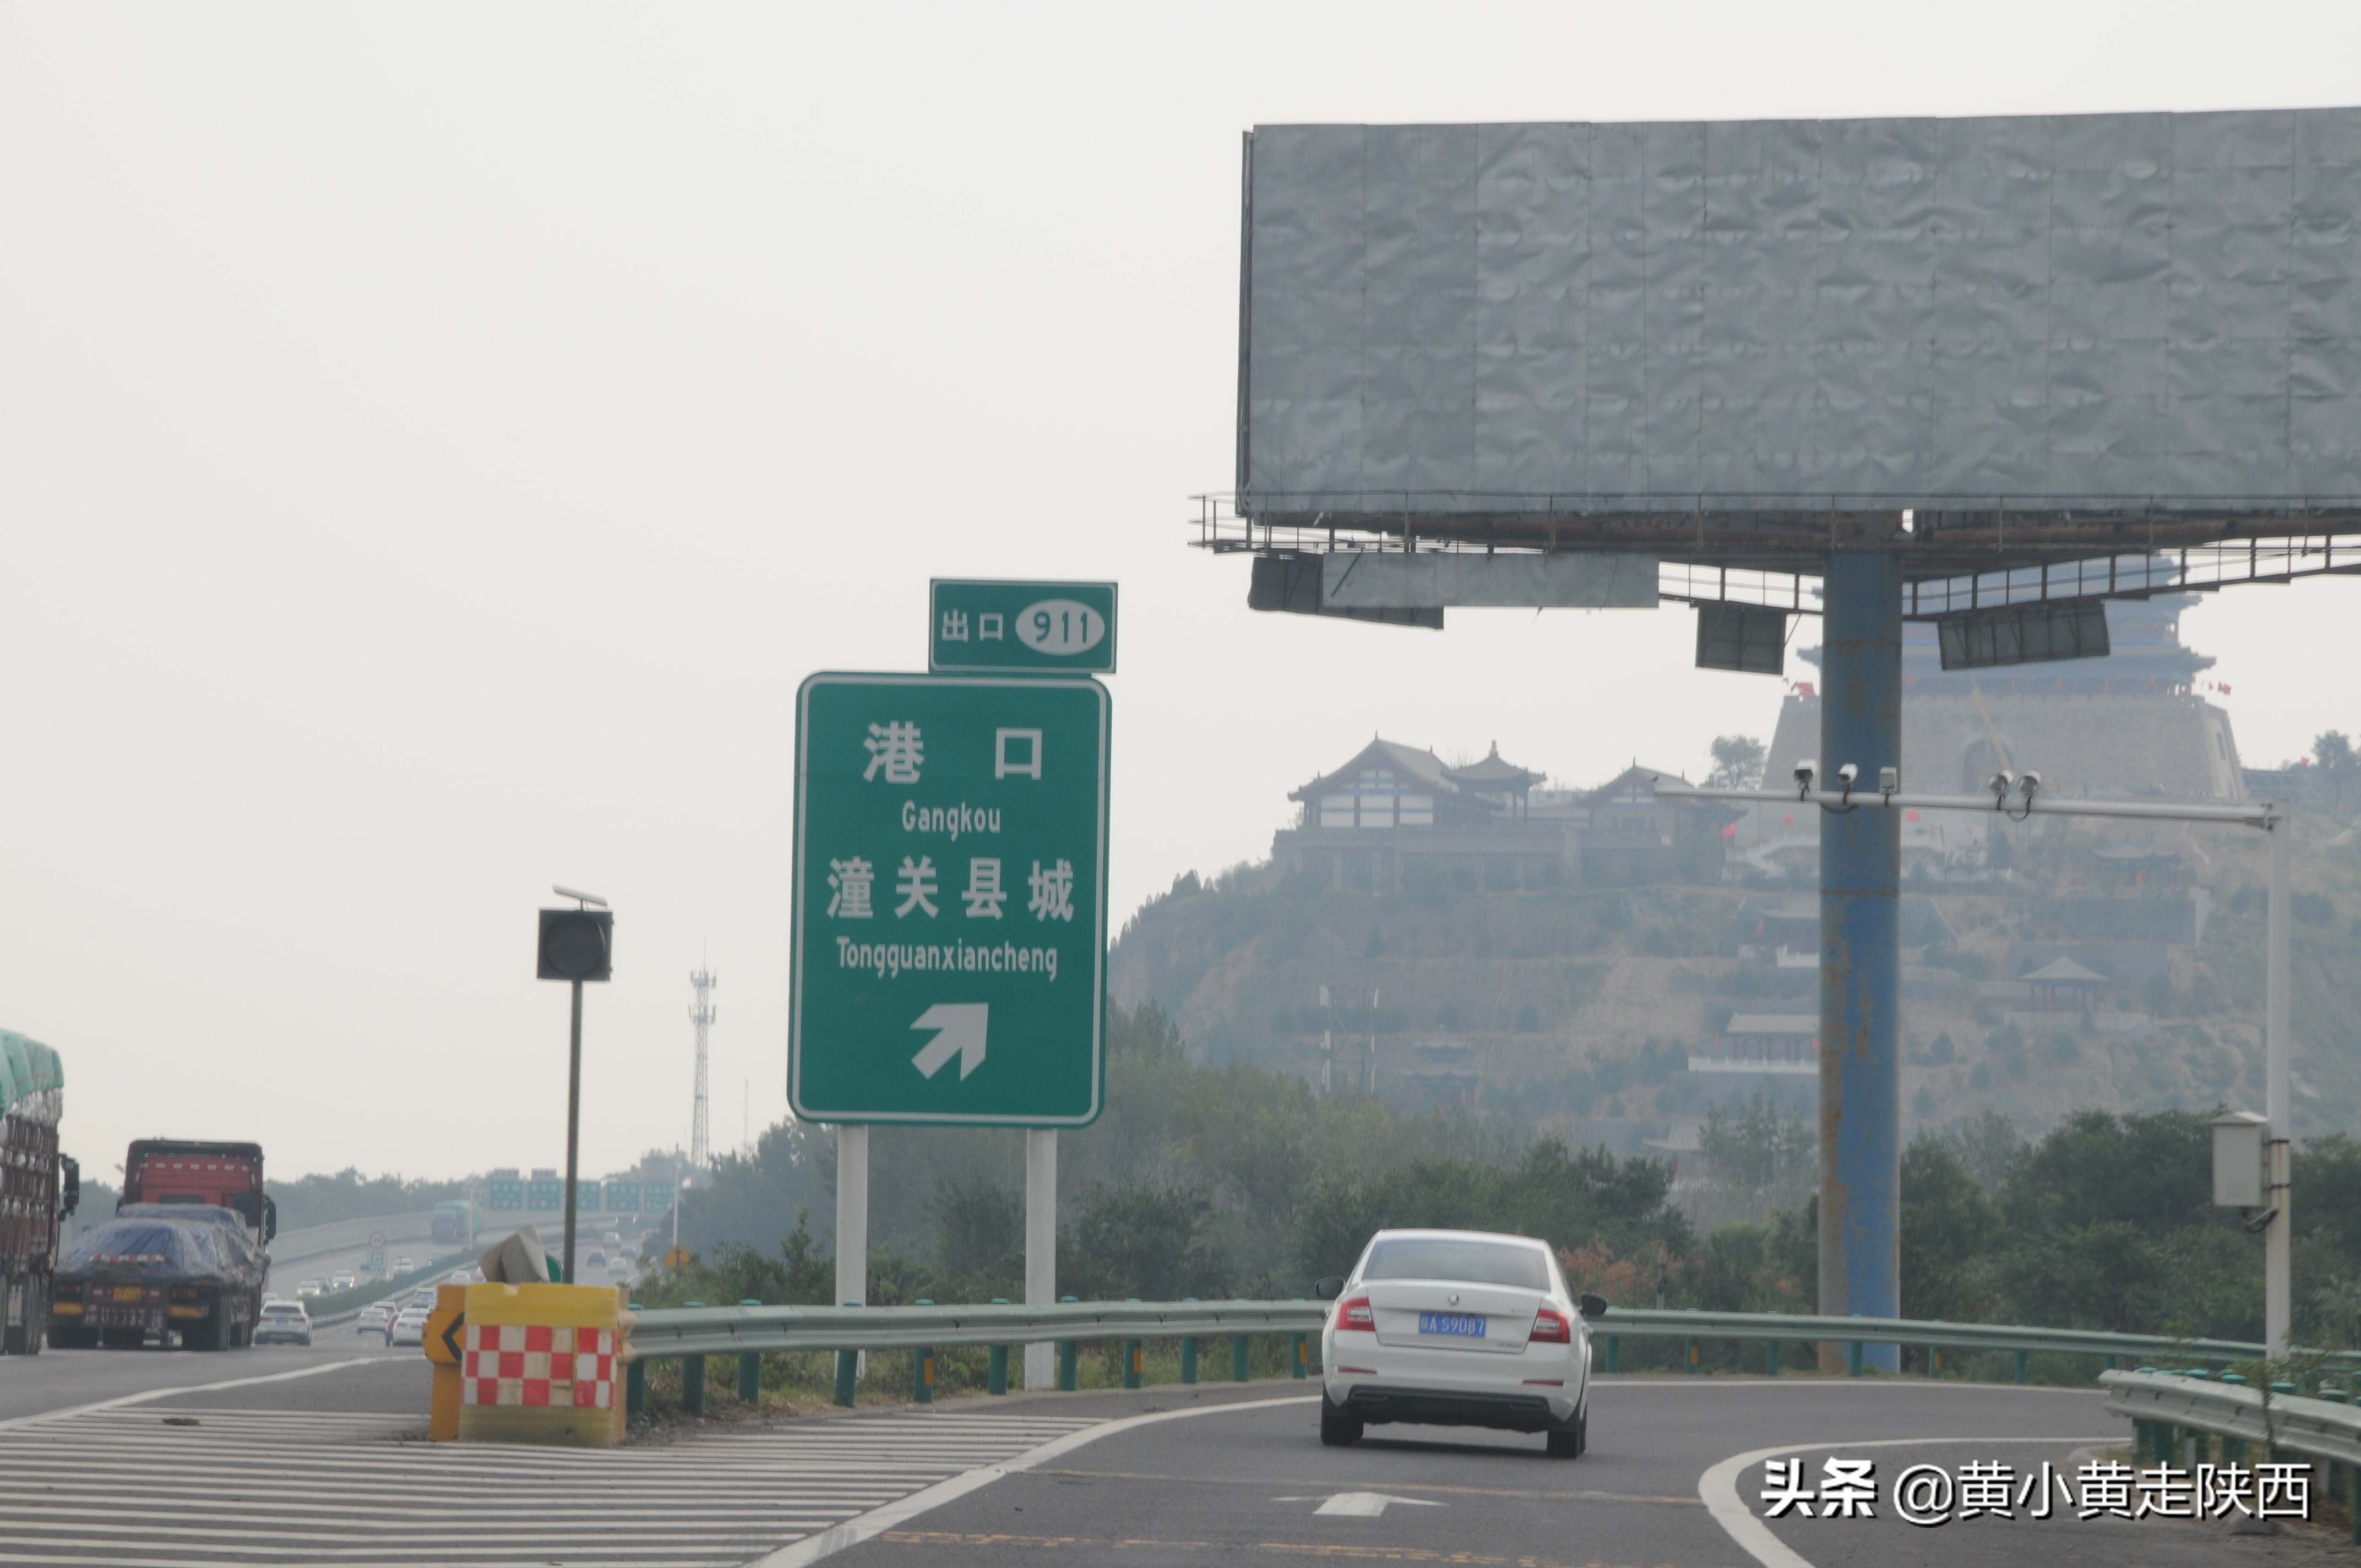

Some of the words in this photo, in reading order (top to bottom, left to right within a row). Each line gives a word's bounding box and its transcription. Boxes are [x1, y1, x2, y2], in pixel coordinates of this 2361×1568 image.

[942, 608, 1004, 643] 出口
[1033, 611, 1088, 644] 911
[863, 720, 1043, 784] 港口
[902, 799, 1001, 842] Gangkou
[826, 855, 1074, 922] 潼关县城
[836, 936, 1058, 982] Tongguanxiancheng
